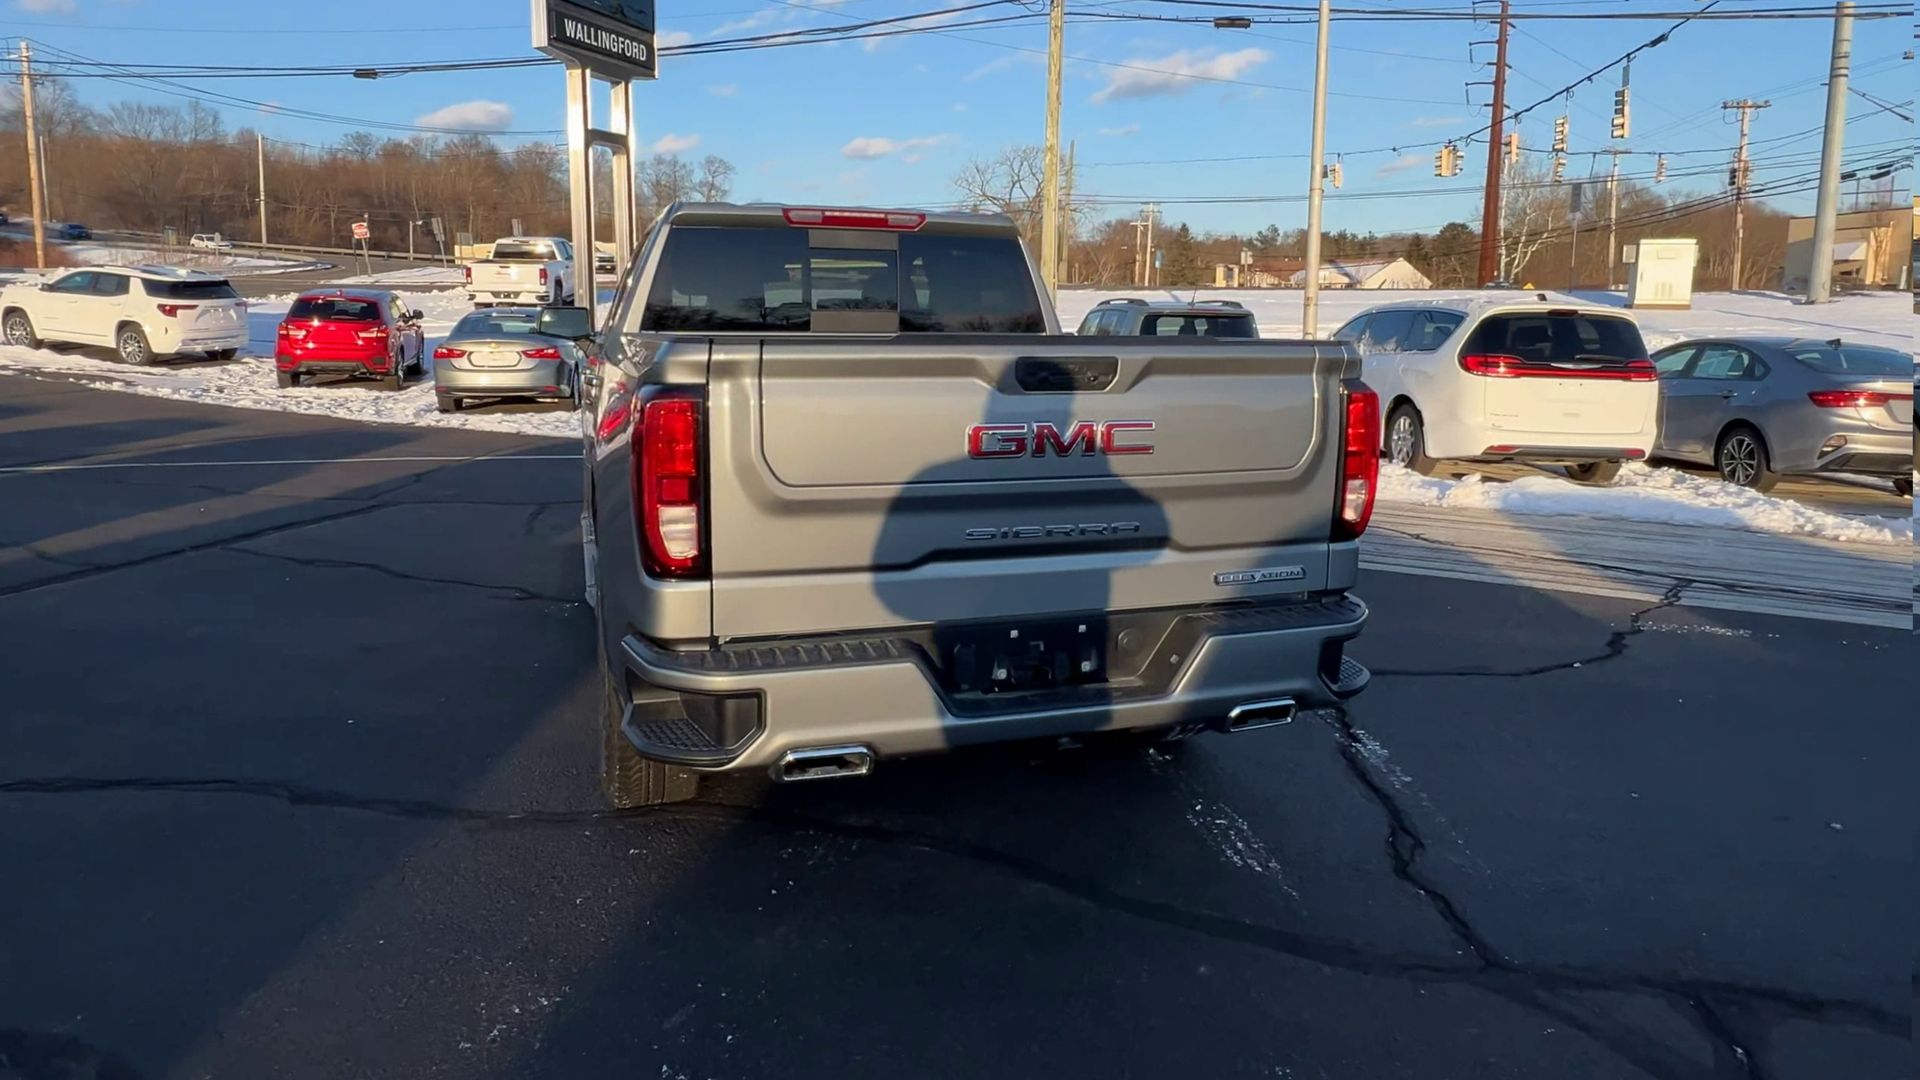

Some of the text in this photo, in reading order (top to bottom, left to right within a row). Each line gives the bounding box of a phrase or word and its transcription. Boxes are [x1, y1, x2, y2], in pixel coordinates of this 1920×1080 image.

[564, 18, 646, 61] WALLINGFORD
[966, 420, 1155, 459] GMC
[965, 521, 1141, 540] SIERRA
